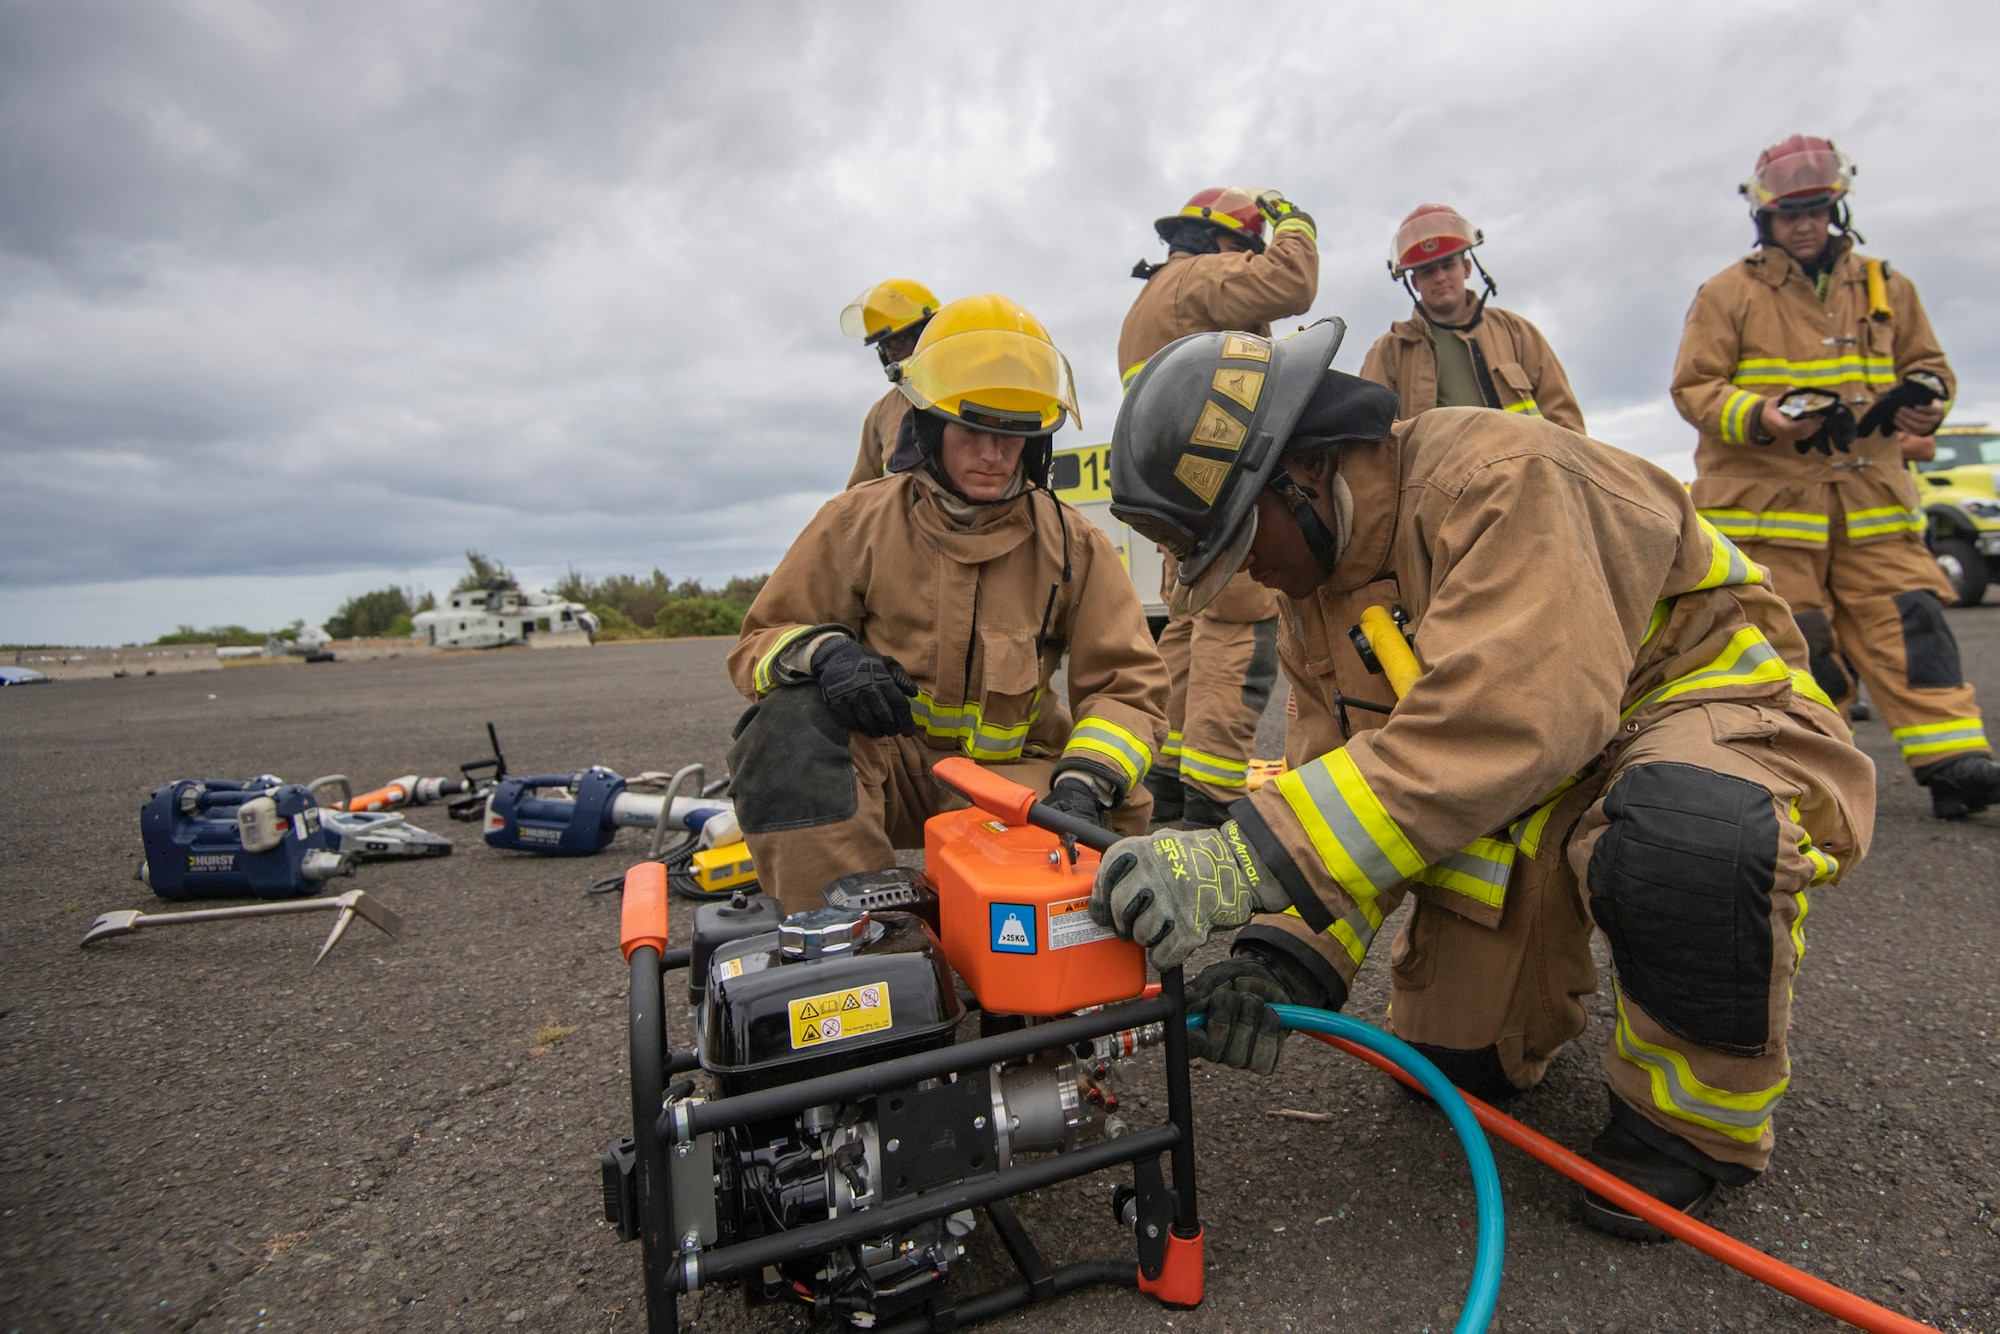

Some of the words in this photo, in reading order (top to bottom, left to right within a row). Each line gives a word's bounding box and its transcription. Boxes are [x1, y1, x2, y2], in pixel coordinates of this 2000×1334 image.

[525, 828, 562, 840] HURST
[195, 855, 235, 865] HURST
[1160, 838, 1187, 880] SR-X
[1228, 820, 1259, 884] HexArmor
